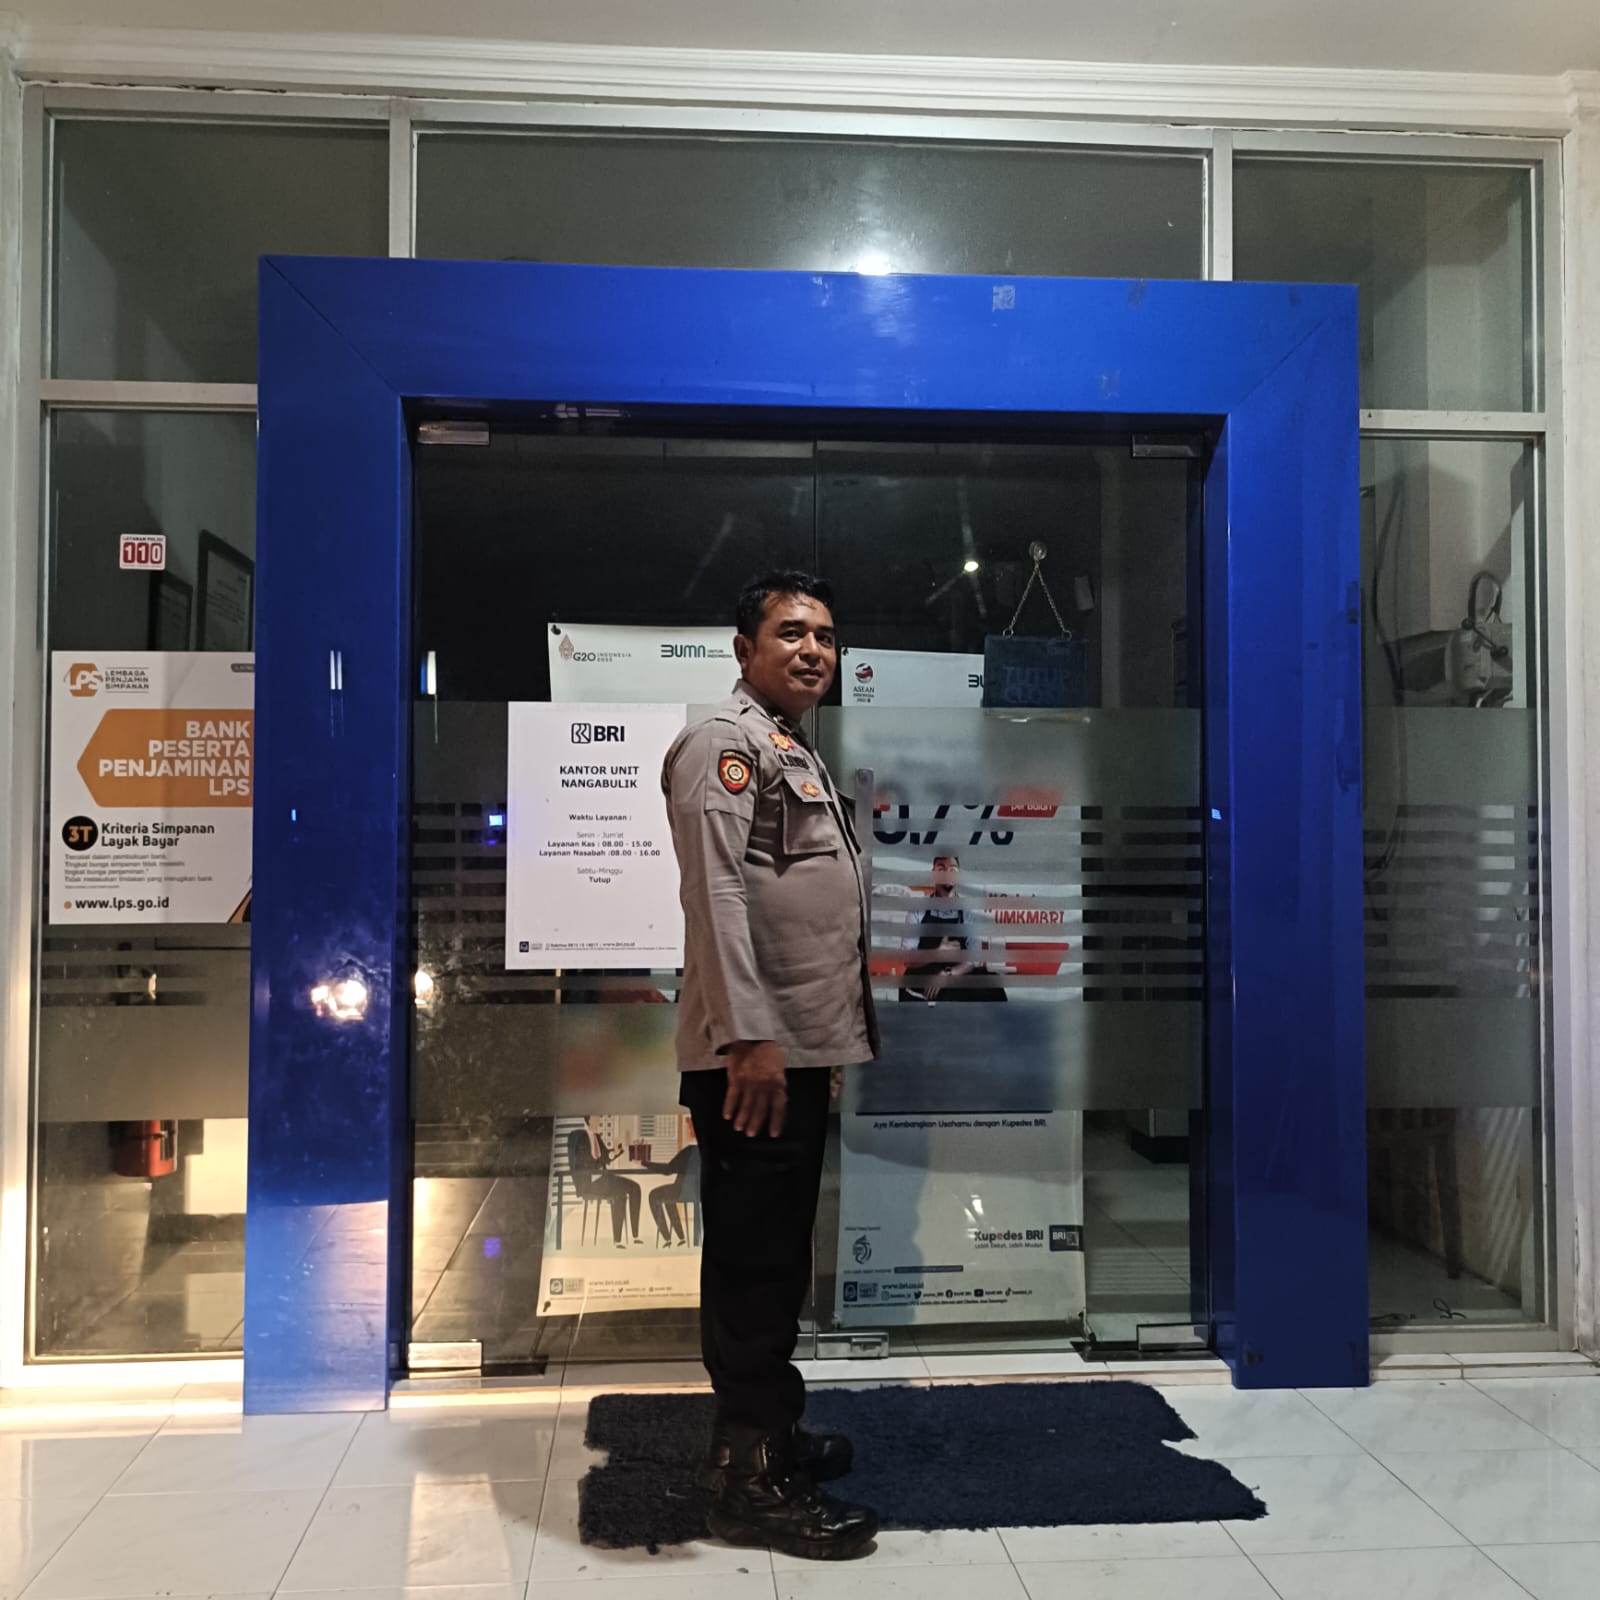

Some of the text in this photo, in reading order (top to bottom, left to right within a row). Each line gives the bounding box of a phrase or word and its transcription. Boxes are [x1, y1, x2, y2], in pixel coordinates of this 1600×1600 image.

[124, 543, 162, 562] 110
[573, 652, 596, 662] G20
[661, 644, 706, 658] BUMN
[853, 685, 875, 693] ASEAN
[186, 720, 250, 738] BANK
[593, 725, 625, 742] BRI
[148, 740, 250, 757] PESERTA
[98, 759, 250, 777] PENJAMINAN
[560, 765, 640, 775] KANTOR UNIT
[209, 778, 250, 796] LPS
[561, 779, 638, 788] NANGABULIK
[595, 814, 628, 822] Layanan
[68, 825, 93, 843] 3T
[101, 822, 215, 836] Kriteria Simpanan
[101, 835, 180, 849] Layak Bayar
[547, 840, 580, 849] Layanan
[539, 849, 571, 857] Layanan
[576, 867, 624, 876] Sabtu-Minggu
[588, 876, 612, 884] Tutup
[75, 896, 170, 911] www.lps.go.id
[974, 1229, 1044, 1243] Kupedes BRI
[1052, 1231, 1066, 1240] BRI
